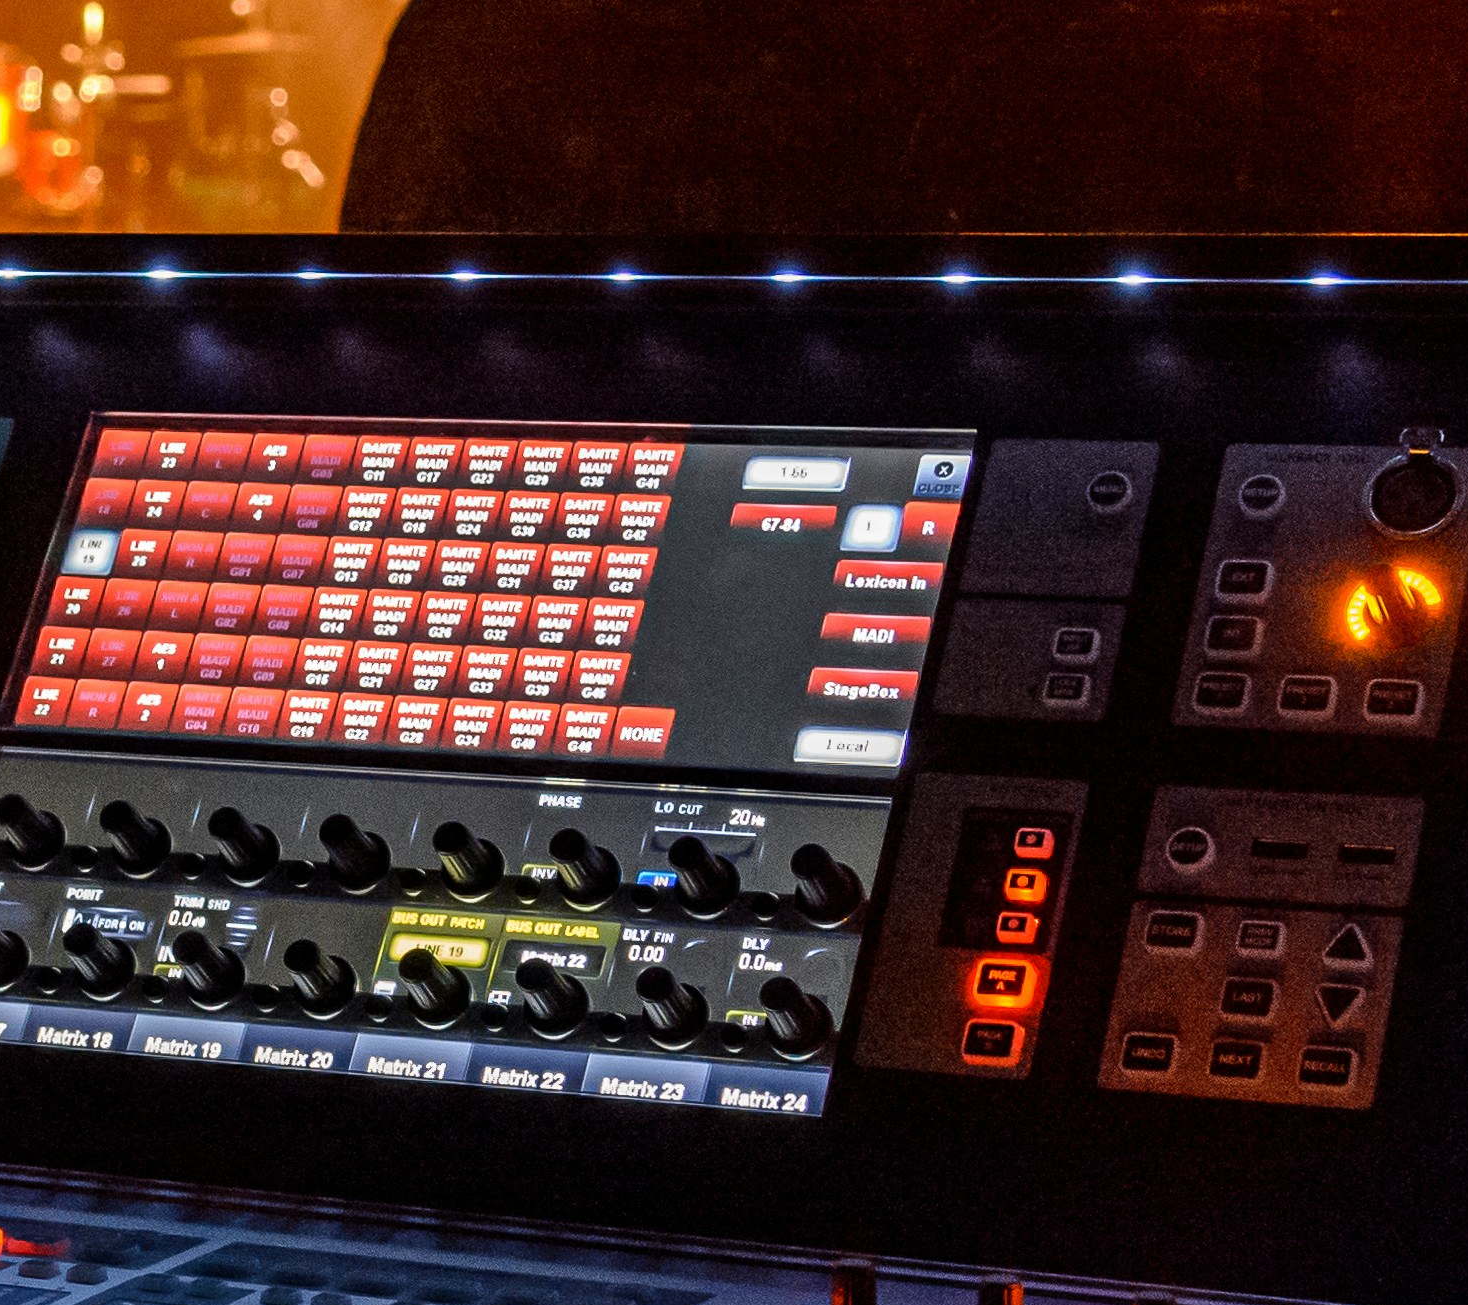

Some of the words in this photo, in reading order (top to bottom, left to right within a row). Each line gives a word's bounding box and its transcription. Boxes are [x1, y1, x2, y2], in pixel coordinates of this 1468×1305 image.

[160, 442, 186, 455] LINE
[362, 442, 402, 454] DANTE
[415, 444, 456, 456] DANTE
[634, 449, 675, 462] DANTE
[363, 457, 395, 469] MADI
[416, 458, 448, 470] MADI
[635, 464, 668, 476] MADI
[145, 491, 172, 504] LINE
[761, 518, 802, 534] 67-84
[922, 520, 937, 535] R
[551, 551, 592, 563] DANTE
[552, 566, 585, 578] MADI
[845, 573, 907, 590] Lexicon
[910, 575, 927, 591] In
[593, 604, 635, 618] DANTE
[594, 619, 628, 633] MADI
[852, 627, 895, 644] MADI
[33, 688, 60, 701] LINE
[824, 682, 900, 700] StageBox
[620, 727, 664, 743] NONE
[826, 738, 869, 753] Local
[539, 795, 583, 809] PHASE
[655, 801, 674, 814] LO
[678, 804, 703, 815] CUT
[531, 868, 557, 880] INV
[653, 876, 669, 886] IN
[67, 887, 104, 901] POINT
[173, 895, 204, 909] TRIM
[129, 920, 146, 932] ON
[392, 911, 418, 925] BUS
[420, 913, 447, 927] OUT
[450, 916, 486, 930] PATCH
[506, 920, 532, 934] BUS
[534, 922, 561, 935] OUT
[564, 925, 600, 939] LABEL
[623, 928, 648, 942] DLY
[654, 931, 675, 944] FIN
[742, 937, 771, 951] DLY
[566, 953, 587, 969] 22
[628, 945, 665, 963] 0.00
[37, 1027, 87, 1048] Matrix
[92, 1032, 114, 1049] 18
[144, 1037, 196, 1057] Matrix
[201, 1042, 221, 1059] 19
[255, 1046, 307, 1068] Matrix
[310, 1052, 333, 1069] 20
[367, 1056, 421, 1078] Matrix
[424, 1062, 447, 1080] 21
[483, 1067, 539, 1088] Matrix
[542, 1072, 565, 1090] 22
[601, 1077, 658, 1099] Matrix
[661, 1083, 685, 1101] 23
[721, 1088, 778, 1110] Matrix
[781, 1094, 808, 1112] 24
